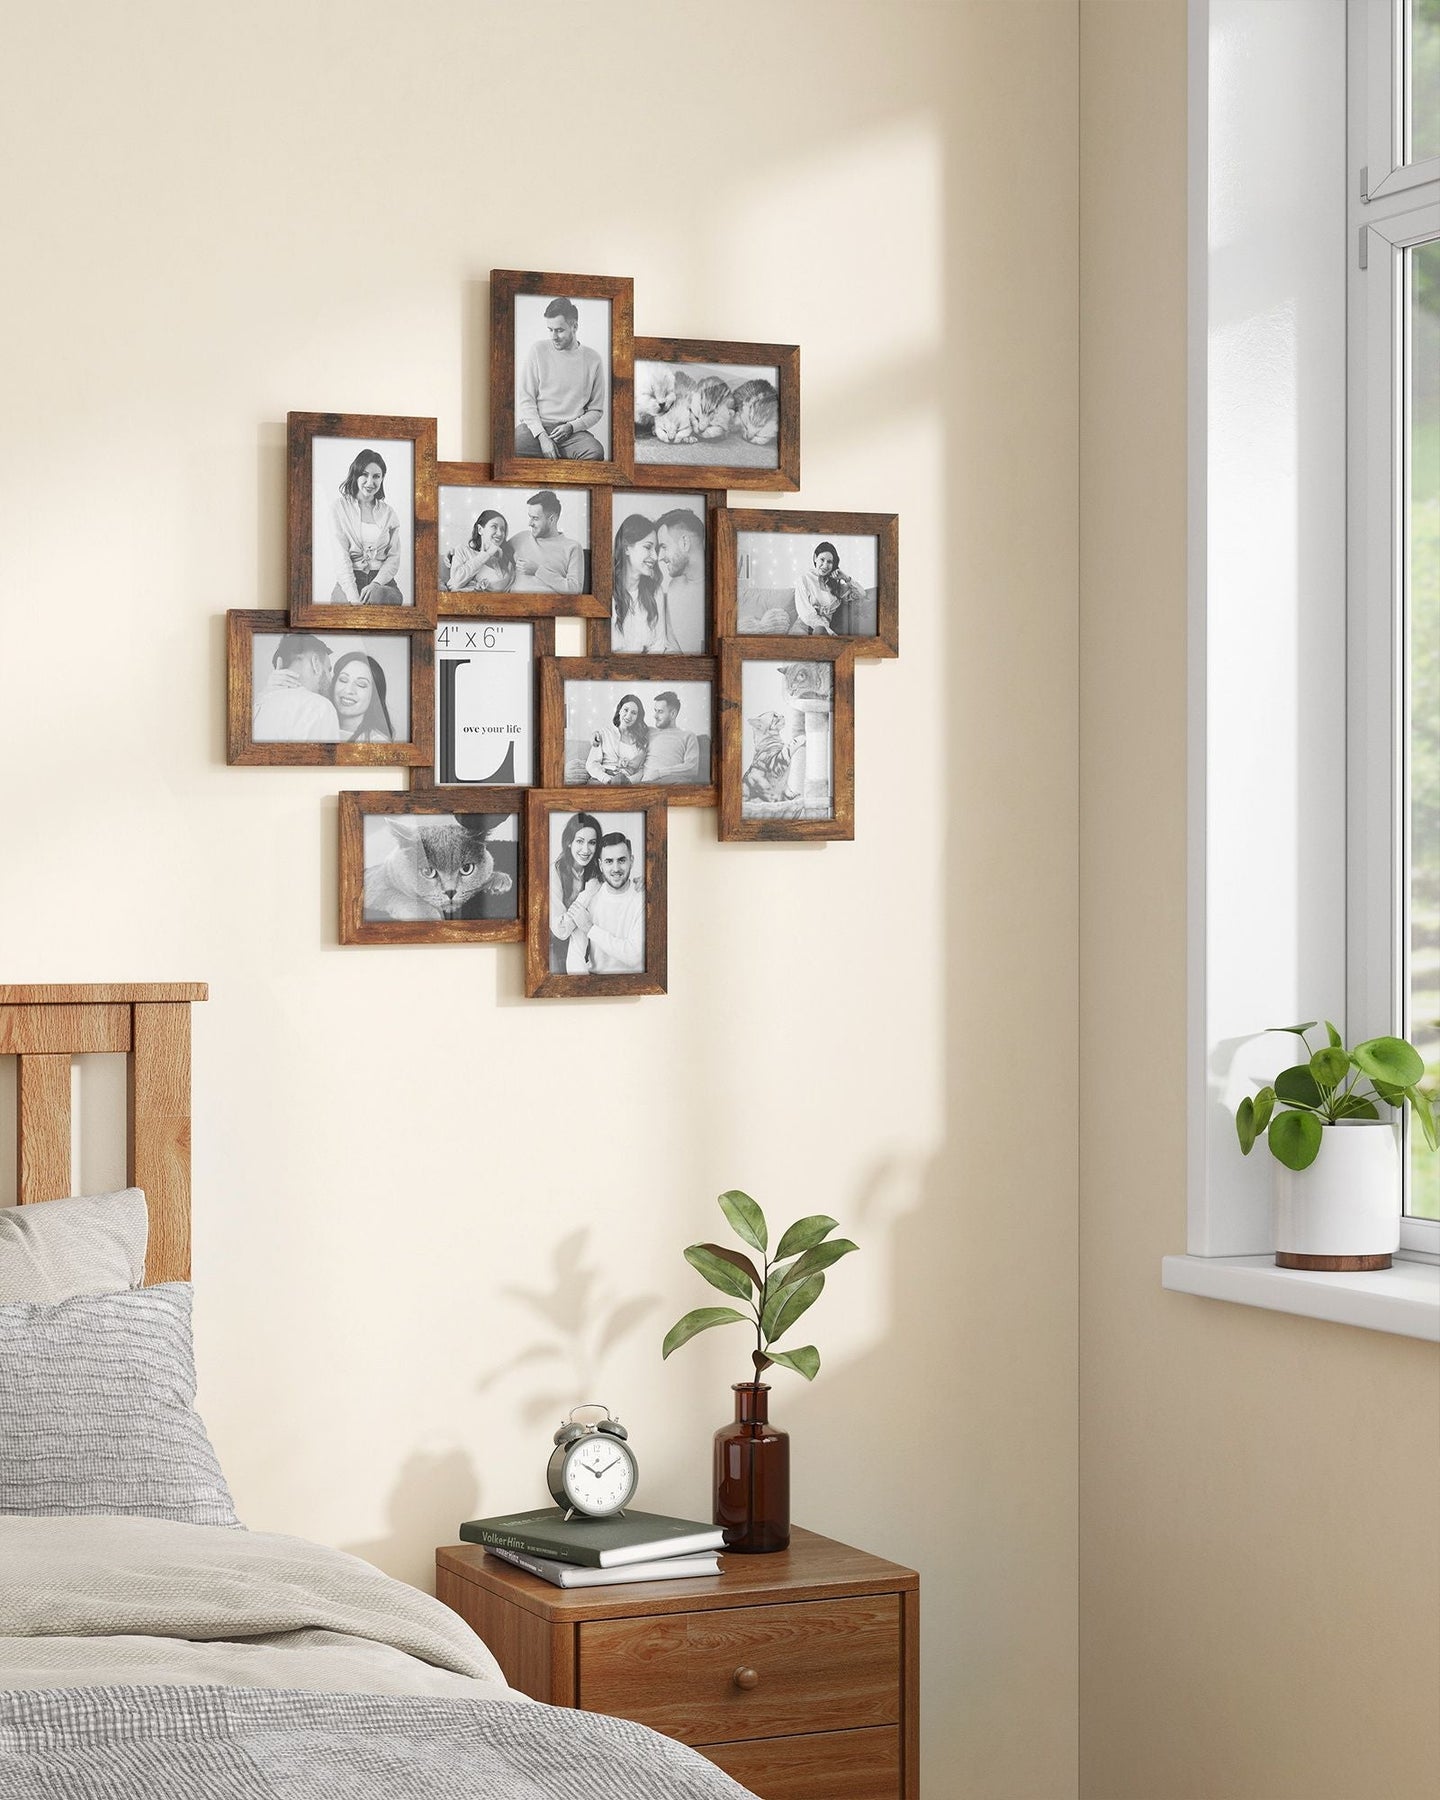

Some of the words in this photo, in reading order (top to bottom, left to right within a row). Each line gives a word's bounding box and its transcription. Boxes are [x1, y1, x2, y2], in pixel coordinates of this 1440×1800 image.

[437, 626, 459, 647] 4"
[483, 627, 504, 648] 6"
[440, 659, 515, 783] L
[481, 726, 504, 735] your
[506, 724, 521, 733] life
[582, 1448, 589, 1457] 11
[593, 1444, 601, 1453] 12
